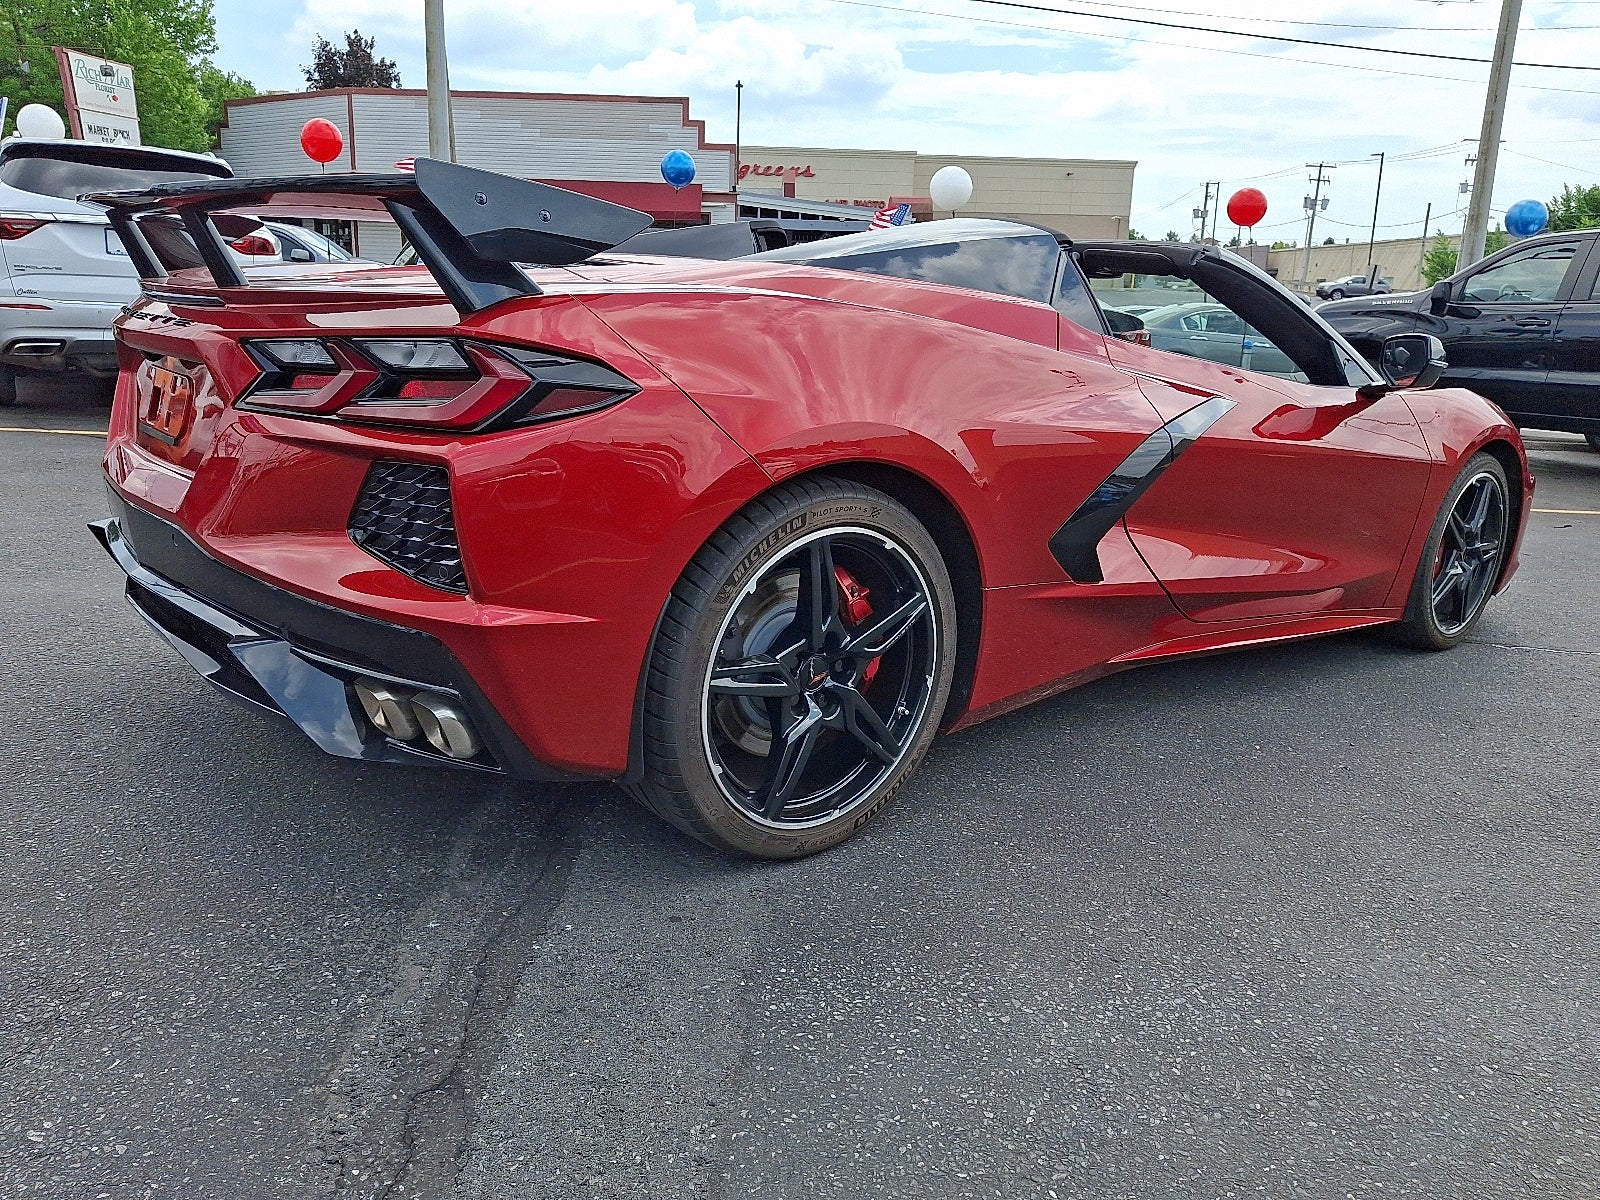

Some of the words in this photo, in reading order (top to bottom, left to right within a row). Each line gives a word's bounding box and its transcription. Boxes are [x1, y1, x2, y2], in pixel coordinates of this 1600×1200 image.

[74, 58, 102, 82] RICH
[95, 83, 116, 94] FLORIST
[87, 123, 110, 137] MARKET
[737, 162, 817, 179] greens
[732, 516, 802, 583] MICHELIN
[811, 507, 833, 518] PILOT
[834, 505, 856, 513] SPORT
[857, 763, 914, 828] MICHELIN
